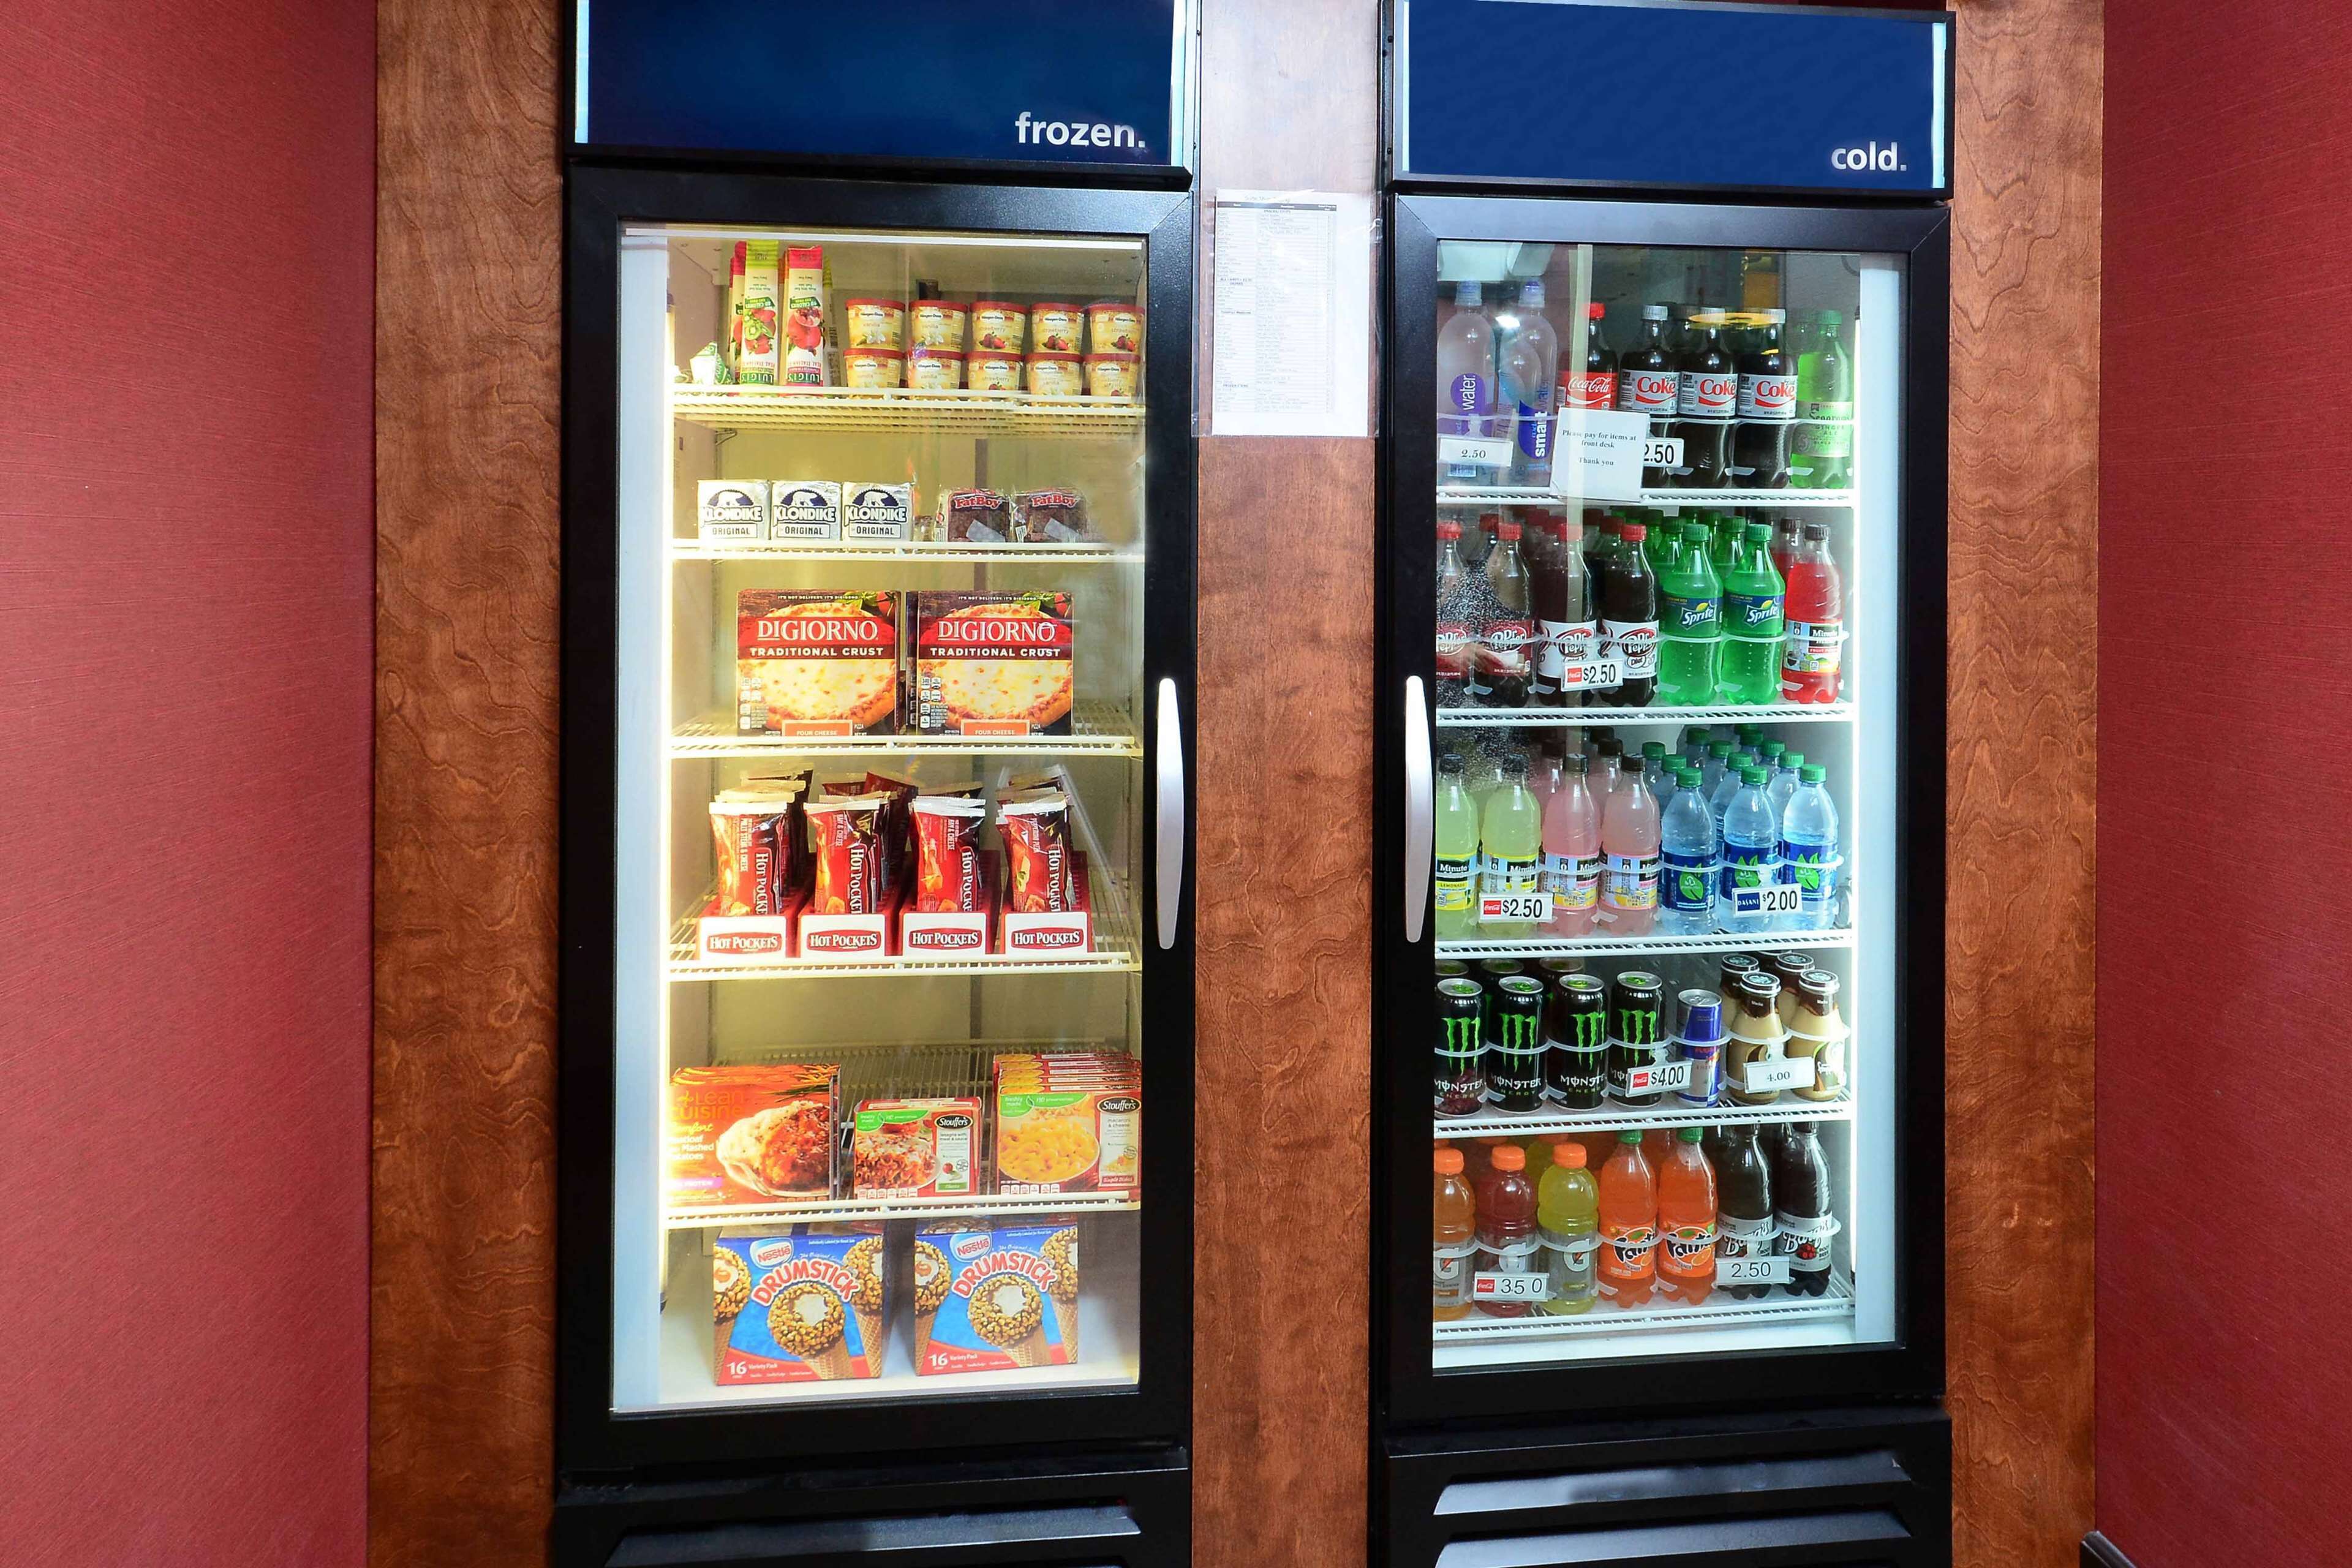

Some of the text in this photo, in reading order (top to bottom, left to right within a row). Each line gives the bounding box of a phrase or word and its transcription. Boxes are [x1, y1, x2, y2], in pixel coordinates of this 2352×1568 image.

[1015, 111, 1145, 148] frozen.
[1831, 141, 1907, 171] cold.
[1461, 375, 1476, 410] water.
[1637, 376, 1676, 394] Coke
[1700, 379, 1736, 395] Coke
[1757, 380, 1795, 397] Coke
[1461, 448, 1486, 459] 2.50
[773, 505, 836, 525] KLONDIKE
[845, 505, 907, 525] KLONDIKE
[712, 527, 750, 535] ORIGINAL
[785, 526, 823, 535] ORIGINAL
[856, 526, 895, 535] ORIGINAL
[1683, 606, 1714, 625] Sprite
[1747, 604, 1779, 623] Sprite
[750, 647, 883, 656] TRADITIONAL CRUST
[930, 647, 1060, 657] TRADITIONAL CRUST
[1583, 664, 1616, 684] $2.50
[1441, 864, 1468, 873] Minute
[756, 853, 768, 914] HOT POCKE
[850, 848, 864, 914] HOT POCKE
[962, 851, 973, 912] HOT POCKE
[1049, 850, 1061, 912] HOT POCKE
[1502, 899, 1542, 918] $2.50
[1763, 891, 1797, 911] $2.00
[710, 935, 778, 949] HOT POCKETS
[810, 933, 878, 947] HOT POCKETS
[913, 932, 979, 944] HOT POCKETS
[1014, 931, 1080, 944] HOT POCKETS
[1560, 1074, 1605, 1088] MONSTE
[1651, 1066, 1684, 1086] $4.00
[1767, 1072, 1790, 1082] 4.00
[695, 1090, 744, 1106] Lean
[1102, 1100, 1136, 1110] Stouffer's
[939, 1116, 968, 1127] Stouffer's
[952, 1251, 1058, 1298] DRUMSTICK
[1731, 1262, 1771, 1278] 2.50
[752, 1258, 861, 1306] DRUMSTICK
[927, 1352, 949, 1366] 16
[726, 1361, 747, 1375] 16
